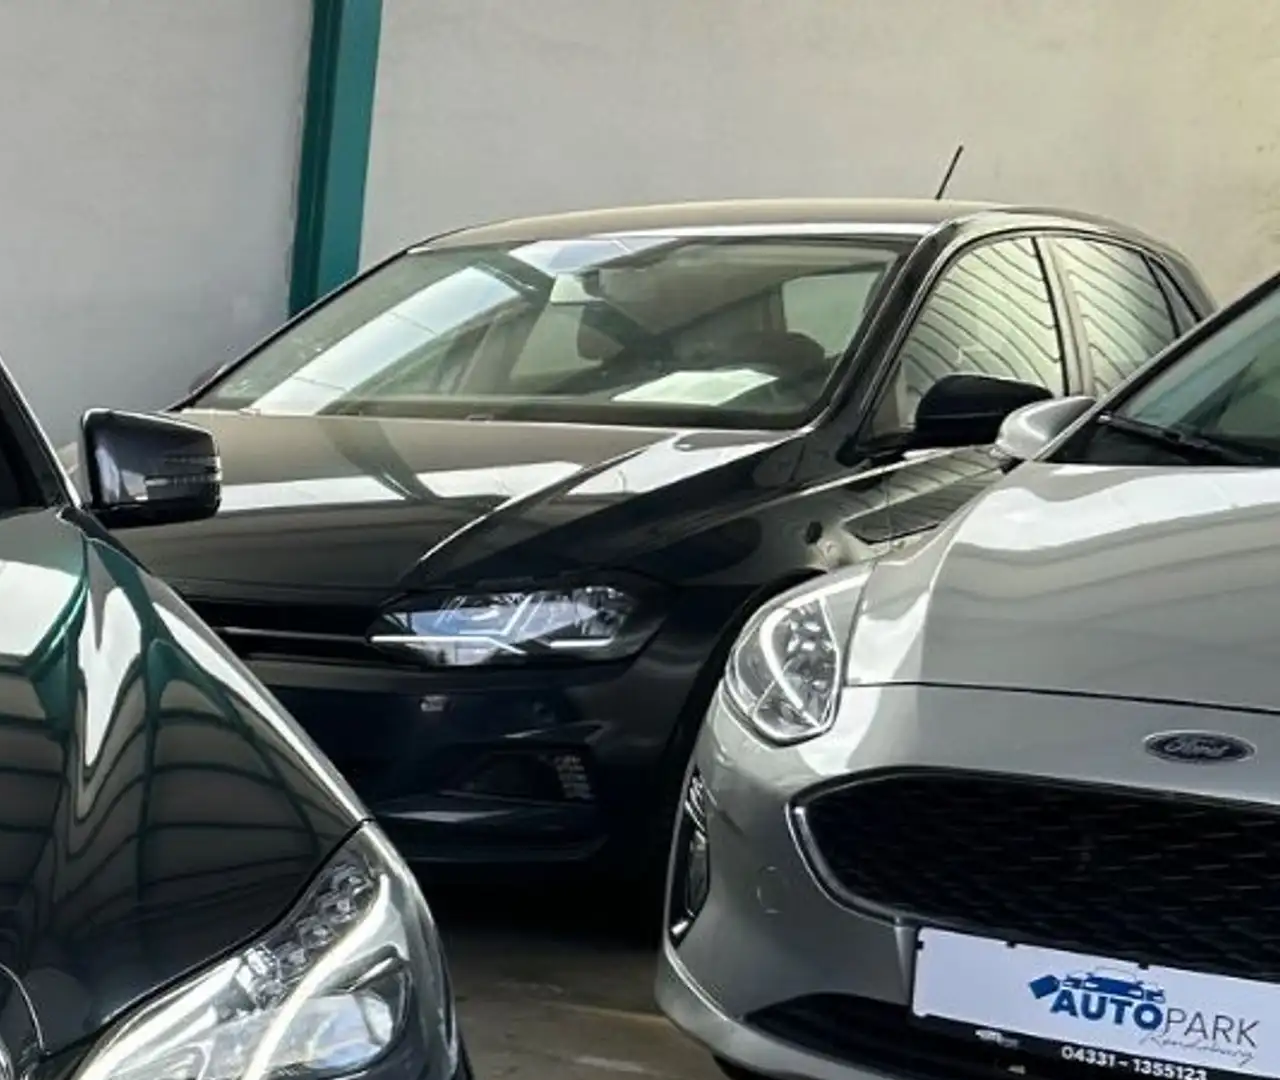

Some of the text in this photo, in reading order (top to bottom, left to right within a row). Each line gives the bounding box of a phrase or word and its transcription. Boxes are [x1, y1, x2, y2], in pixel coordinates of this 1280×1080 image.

[1164, 738, 1230, 758] Ford
[1049, 988, 1261, 1048] AUTOPARK
[1061, 1044, 1116, 1069] 04331
